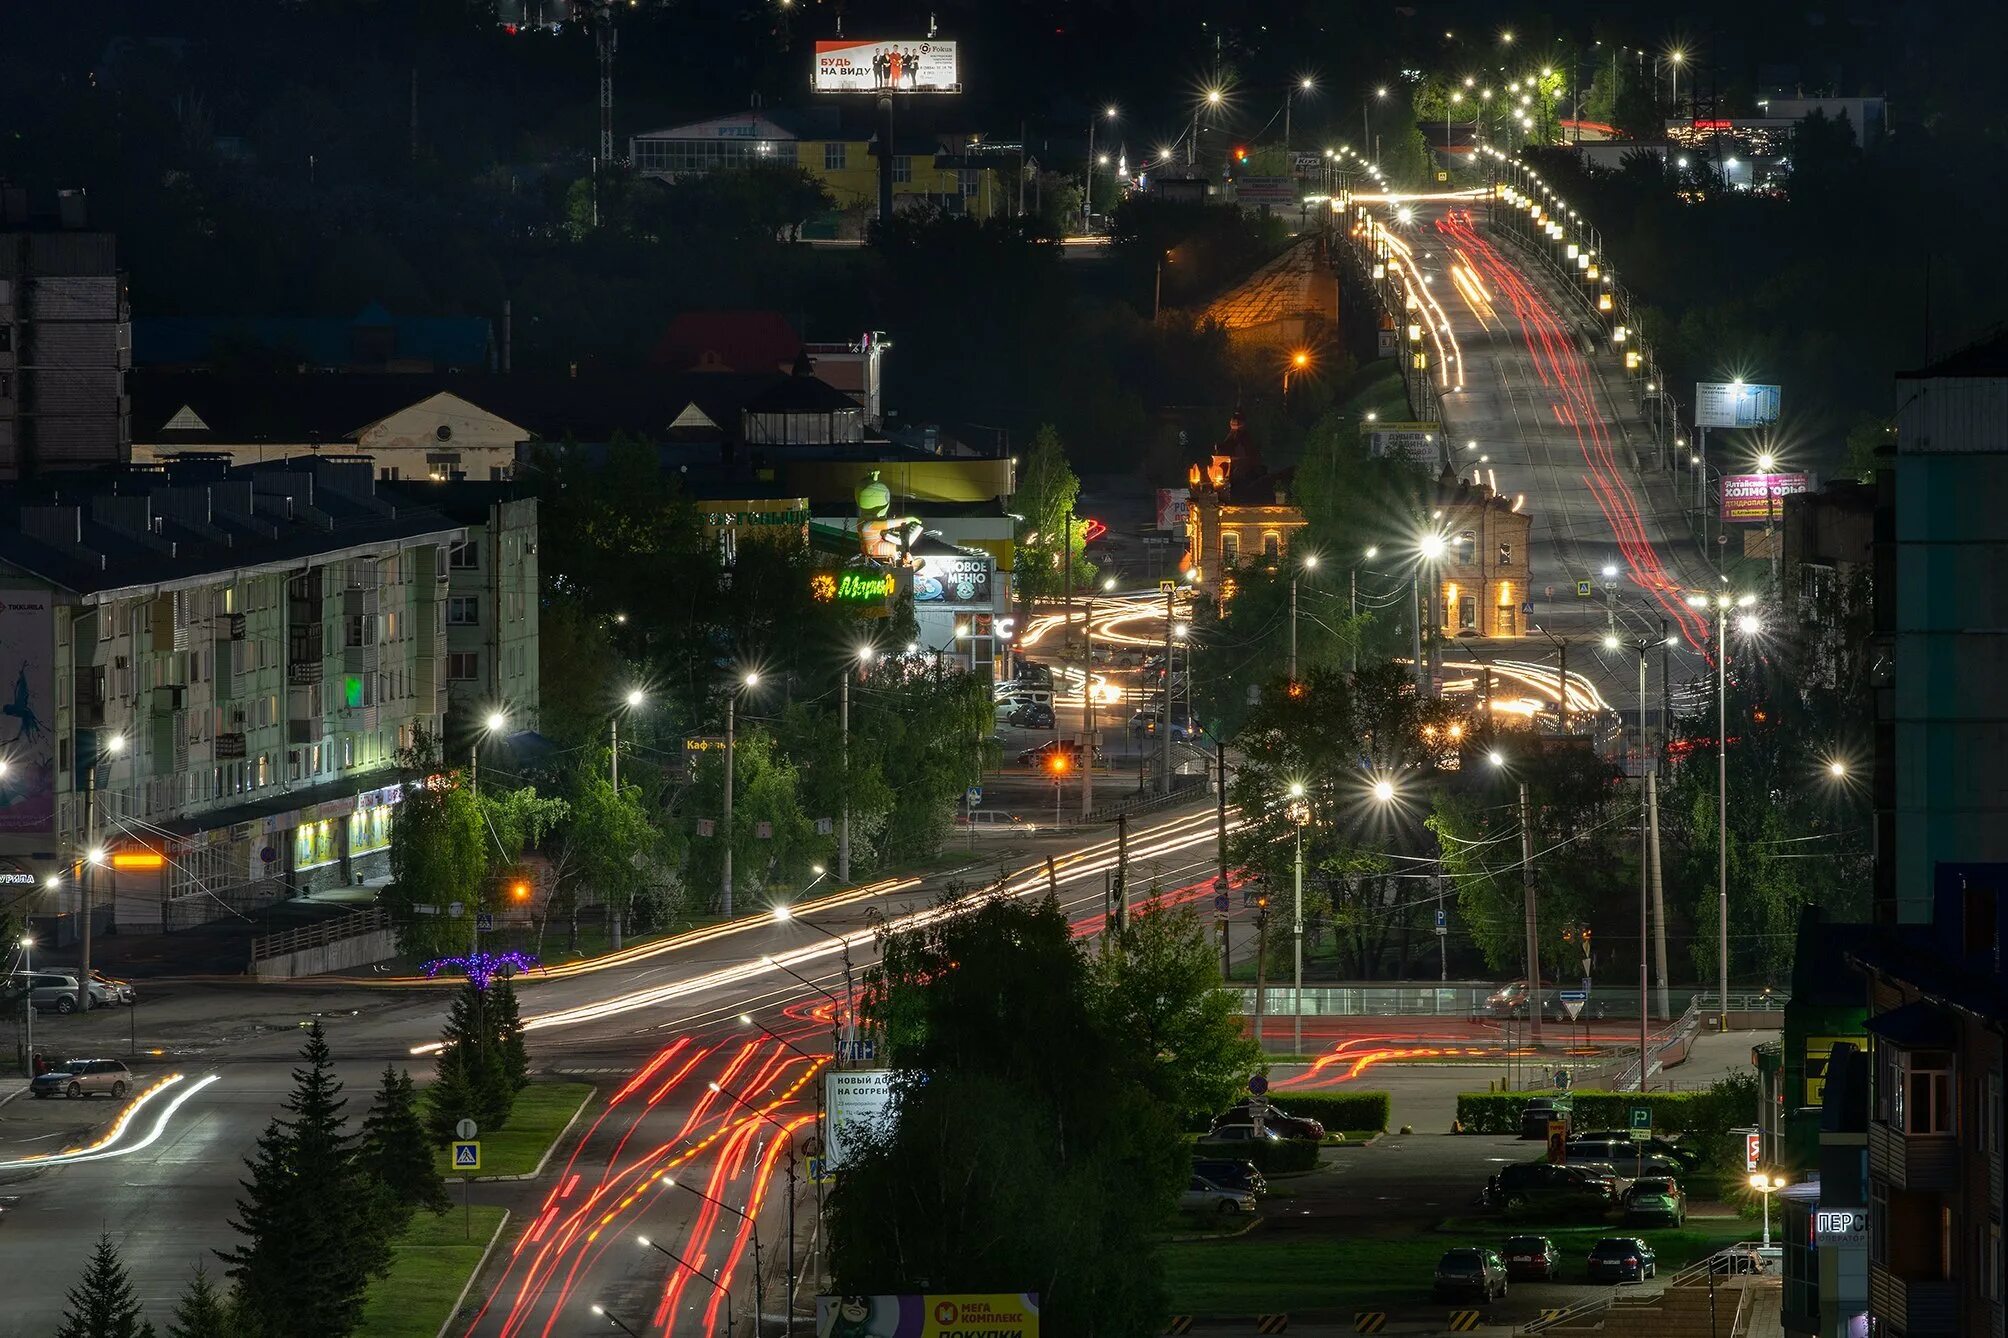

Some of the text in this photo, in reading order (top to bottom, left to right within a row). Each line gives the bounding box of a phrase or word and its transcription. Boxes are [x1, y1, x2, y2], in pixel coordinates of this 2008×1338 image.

[932, 45, 952, 53] Fokus
[820, 58, 850, 67] БУДЬ
[821, 67, 871, 76] НА ВИДУ
[948, 573, 986, 583] МЕНЮ
[838, 1076, 872, 1085] НОВЫЙ
[1819, 1234, 1865, 1242] ОПЕРАТОР
[961, 1303, 991, 1313] МЕГА
[961, 1313, 1024, 1324] КОМПЛЕКС
